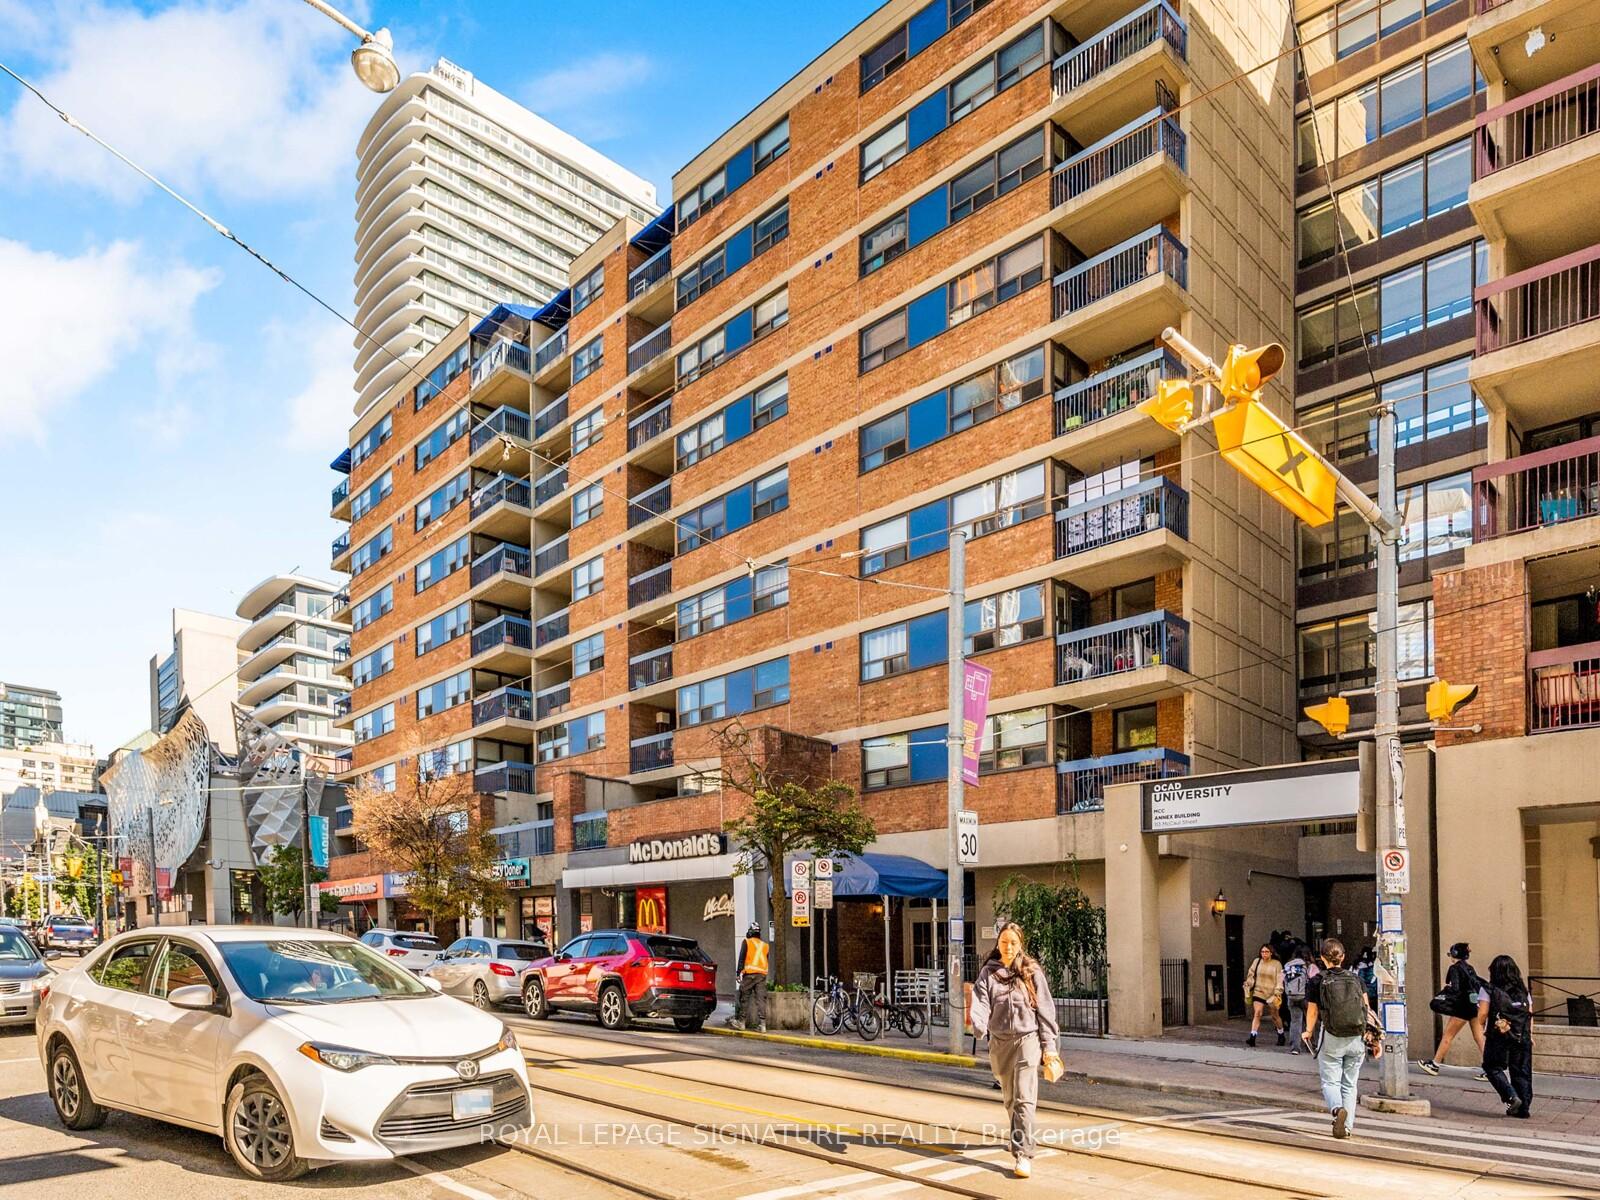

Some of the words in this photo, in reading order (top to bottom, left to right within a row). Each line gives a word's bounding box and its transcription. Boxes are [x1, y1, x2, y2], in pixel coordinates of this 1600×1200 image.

[1153, 782, 1182, 792] OCAD
[1153, 785, 1232, 803] UNIVERSITY
[1174, 812, 1201, 820] BUILDING
[629, 833, 721, 862] McDonald's
[961, 832, 977, 857] 30
[703, 893, 735, 920] McCaf
